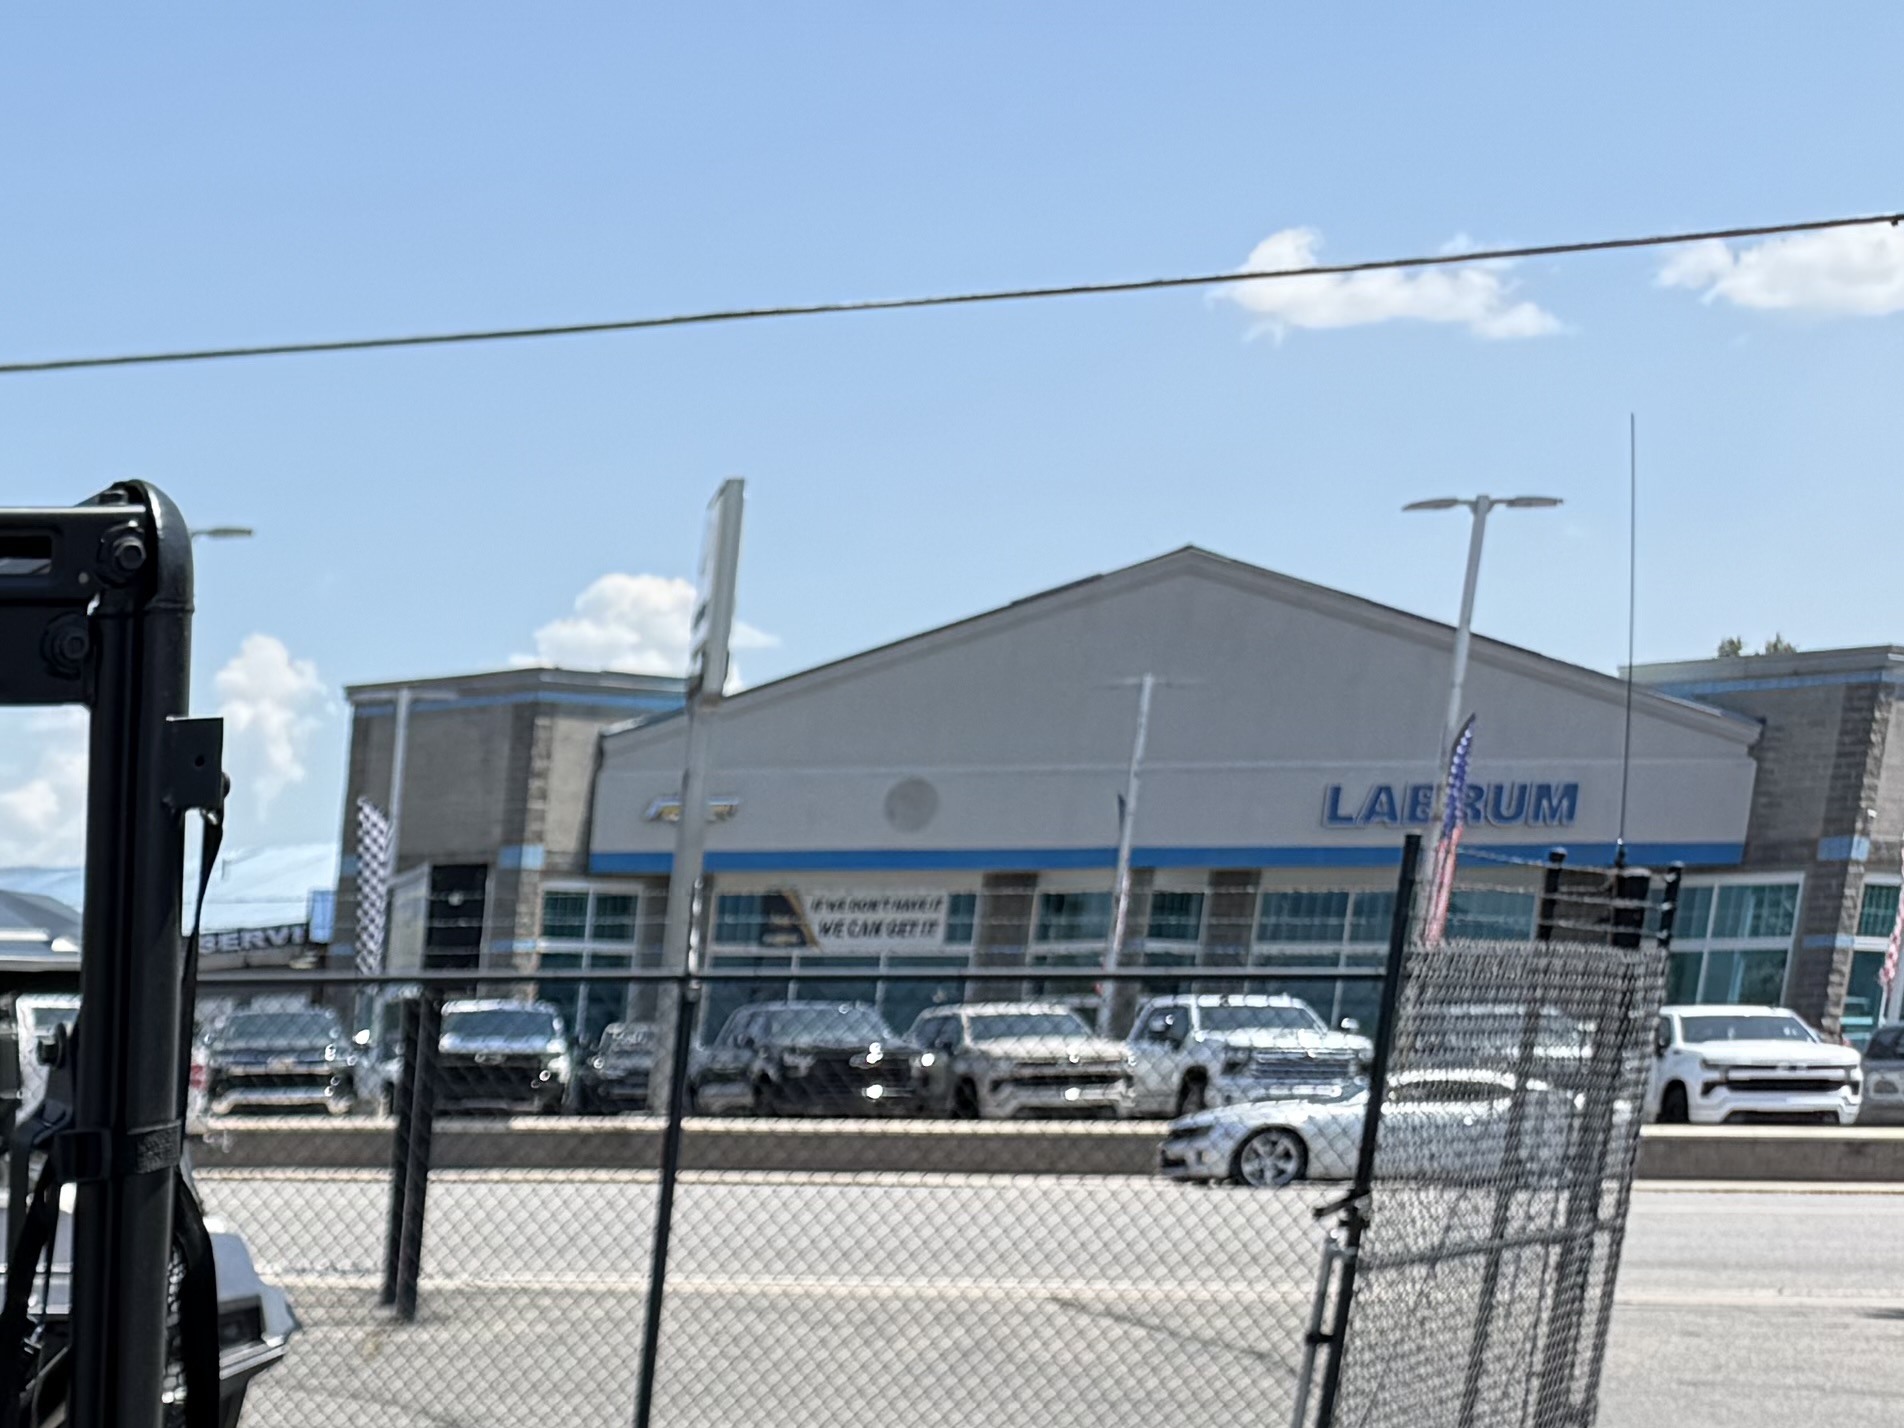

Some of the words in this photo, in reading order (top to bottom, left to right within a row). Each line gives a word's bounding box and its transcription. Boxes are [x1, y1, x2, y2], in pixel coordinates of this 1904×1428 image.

[1324, 781, 1580, 827] LABRUM
[198, 926, 305, 955] SERVI
[819, 919, 845, 938] WE
[847, 919, 882, 938] CAN
